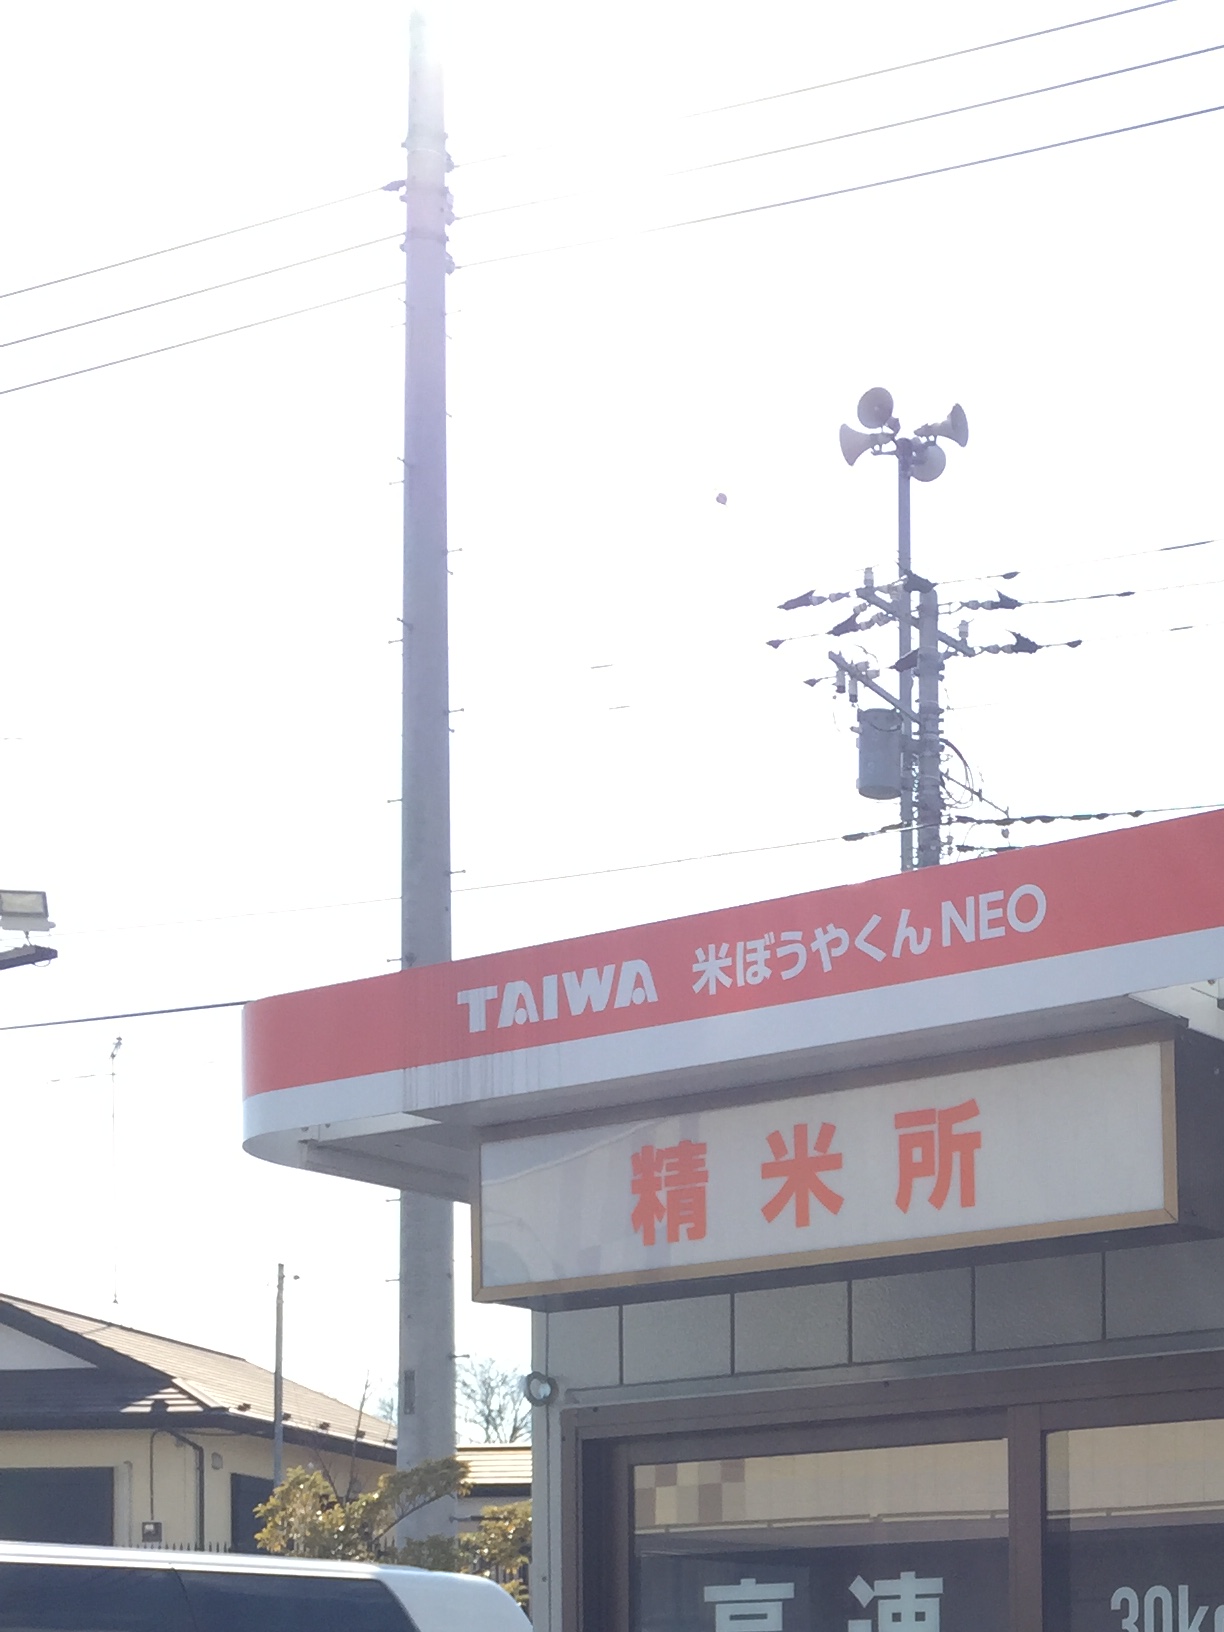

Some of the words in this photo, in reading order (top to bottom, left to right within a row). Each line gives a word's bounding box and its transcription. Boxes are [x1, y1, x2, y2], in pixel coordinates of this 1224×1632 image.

[457, 958, 659, 1034] TAIWA
[629, 1097, 982, 1247] 精米所
